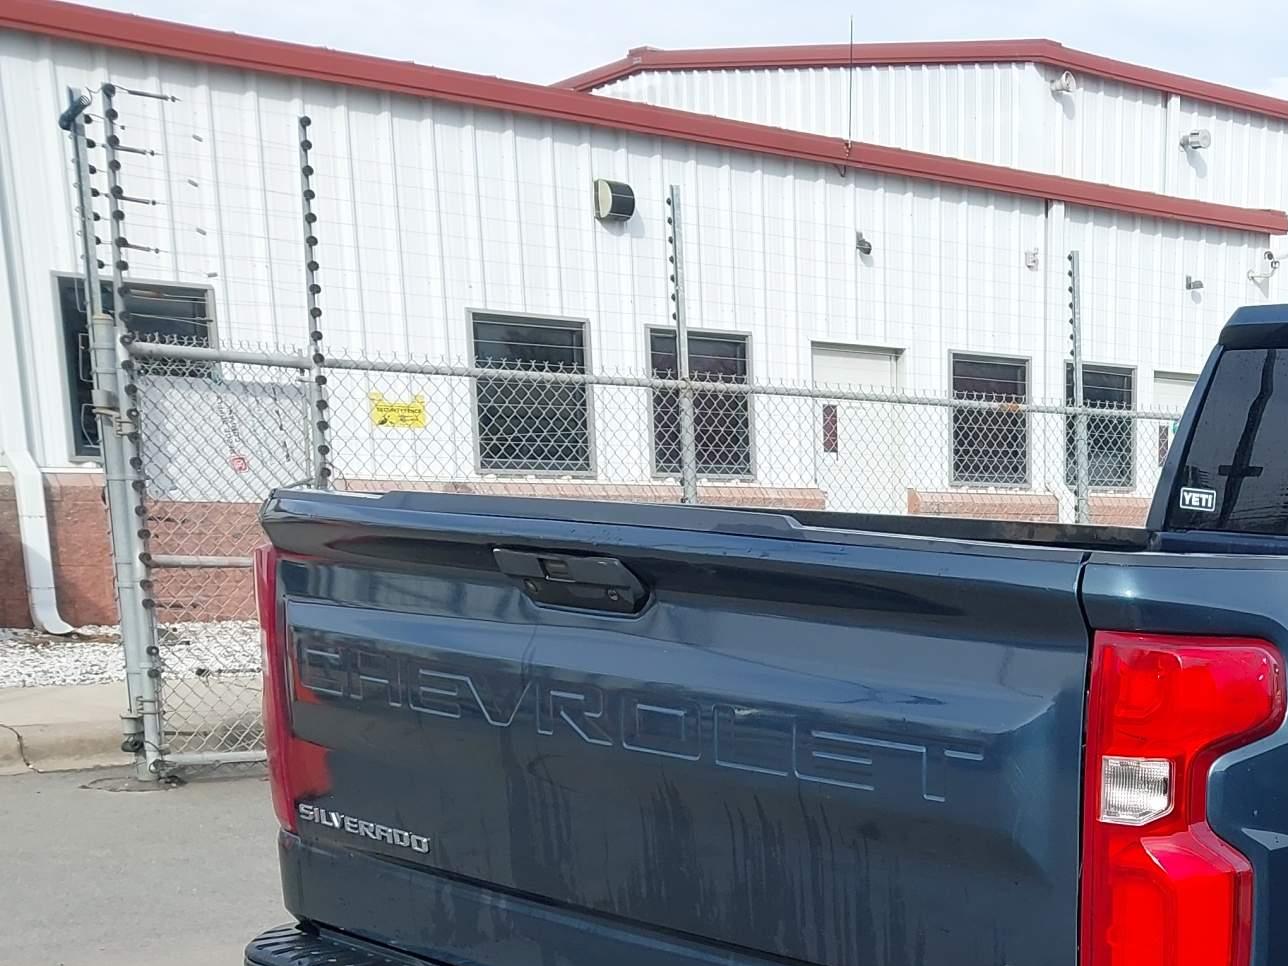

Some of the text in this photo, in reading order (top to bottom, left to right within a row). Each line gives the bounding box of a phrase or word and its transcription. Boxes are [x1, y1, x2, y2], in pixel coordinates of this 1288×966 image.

[1183, 491, 1213, 508] YETI
[299, 645, 984, 802] CHEVROLET
[298, 803, 431, 854] SILVERADO
